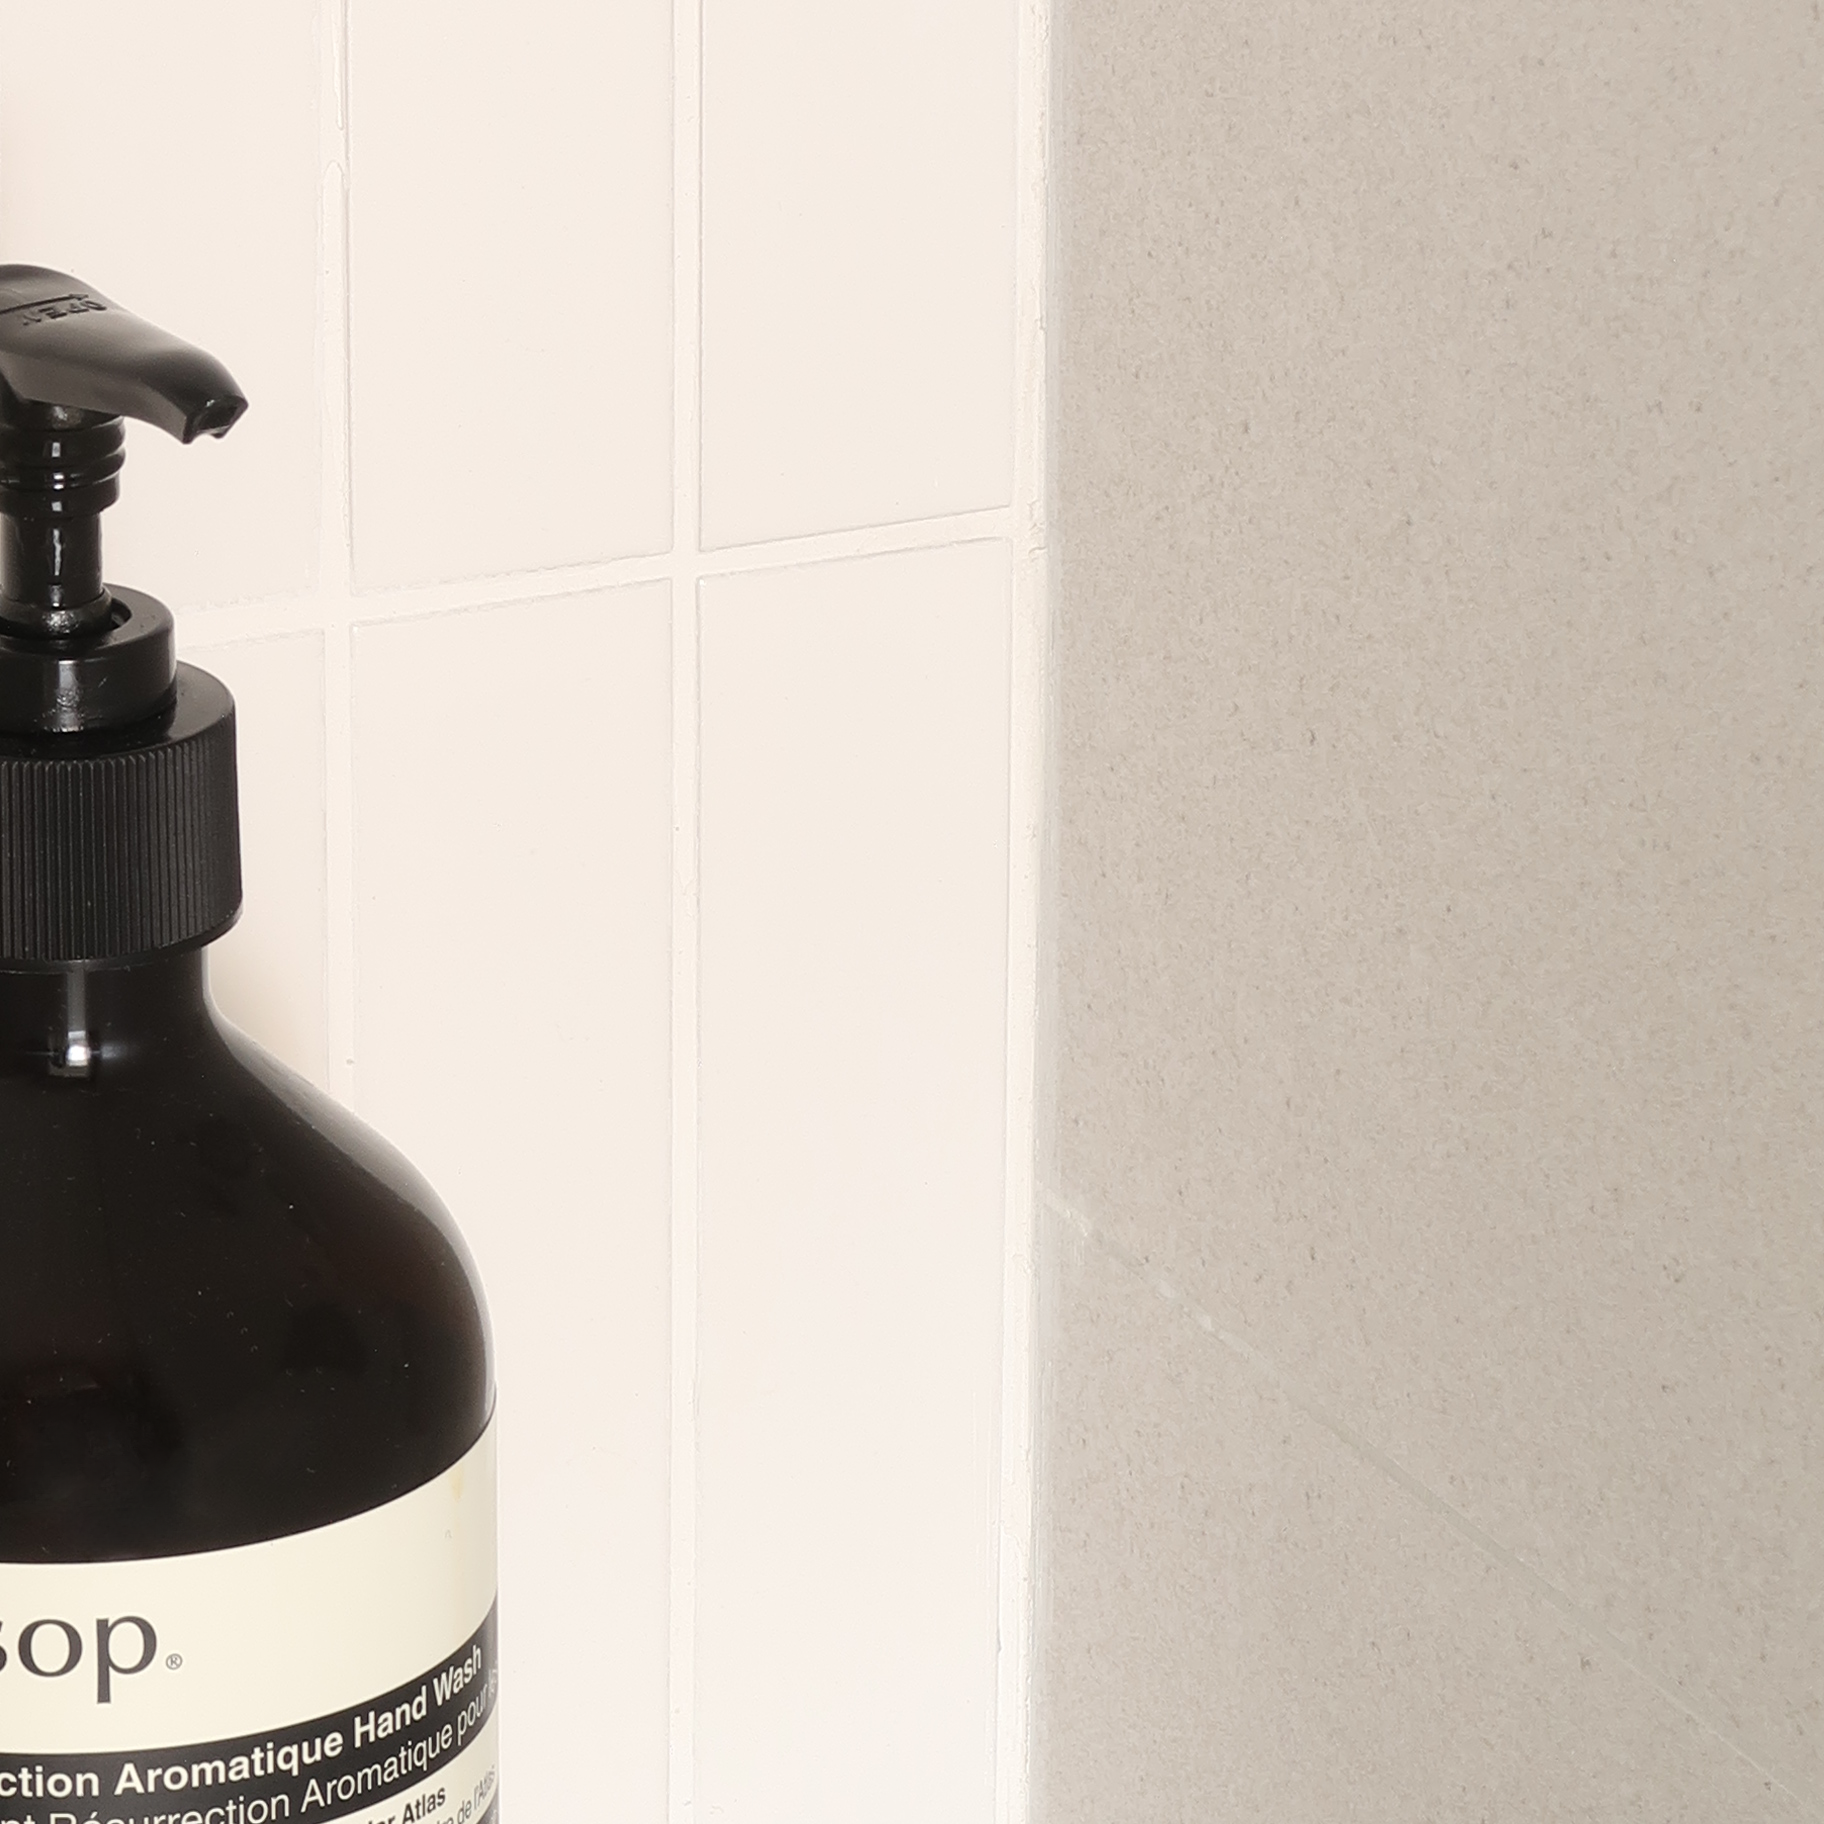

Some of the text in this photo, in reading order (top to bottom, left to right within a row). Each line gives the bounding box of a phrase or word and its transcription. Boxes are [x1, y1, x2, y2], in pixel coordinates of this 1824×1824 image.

[114, 1730, 344, 1796] Aromatique
[353, 1684, 427, 1748] Hand
[432, 1644, 482, 1707] Wash
[300, 1723, 453, 1813] Aromatique
[457, 1683, 488, 1746] pour
